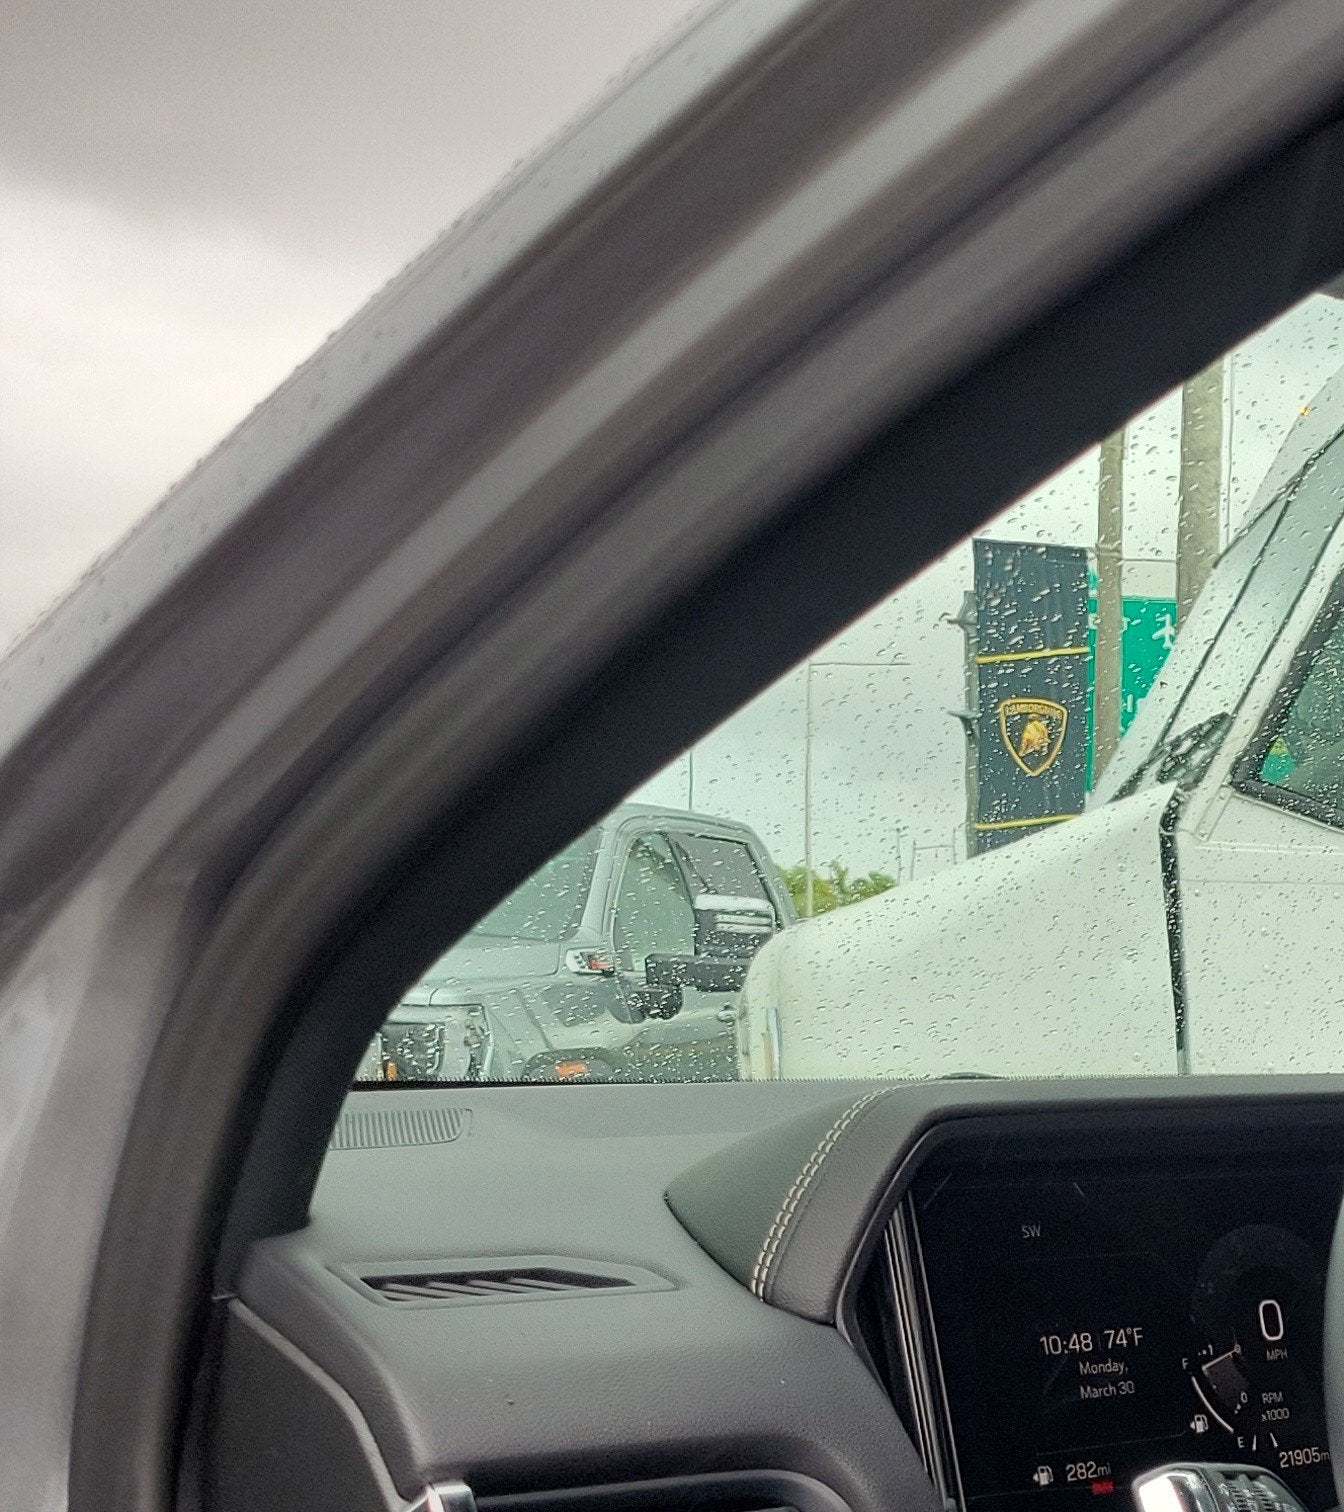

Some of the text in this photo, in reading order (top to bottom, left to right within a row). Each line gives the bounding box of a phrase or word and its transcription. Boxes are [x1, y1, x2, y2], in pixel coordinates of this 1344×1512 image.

[1021, 1224, 1041, 1238] SW
[1259, 1299, 1284, 1341] 0
[1040, 1327, 1143, 1355] 10:48 74°F
[1266, 1348, 1288, 1361] MPH
[1079, 1358, 1129, 1375] Monday,
[1181, 1357, 1189, 1370] F
[1080, 1380, 1135, 1399] March 30
[1262, 1391, 1284, 1404] RPM
[1261, 1407, 1290, 1422] x1000
[1237, 1436, 1245, 1449] E
[1279, 1447, 1330, 1469] 21905m
